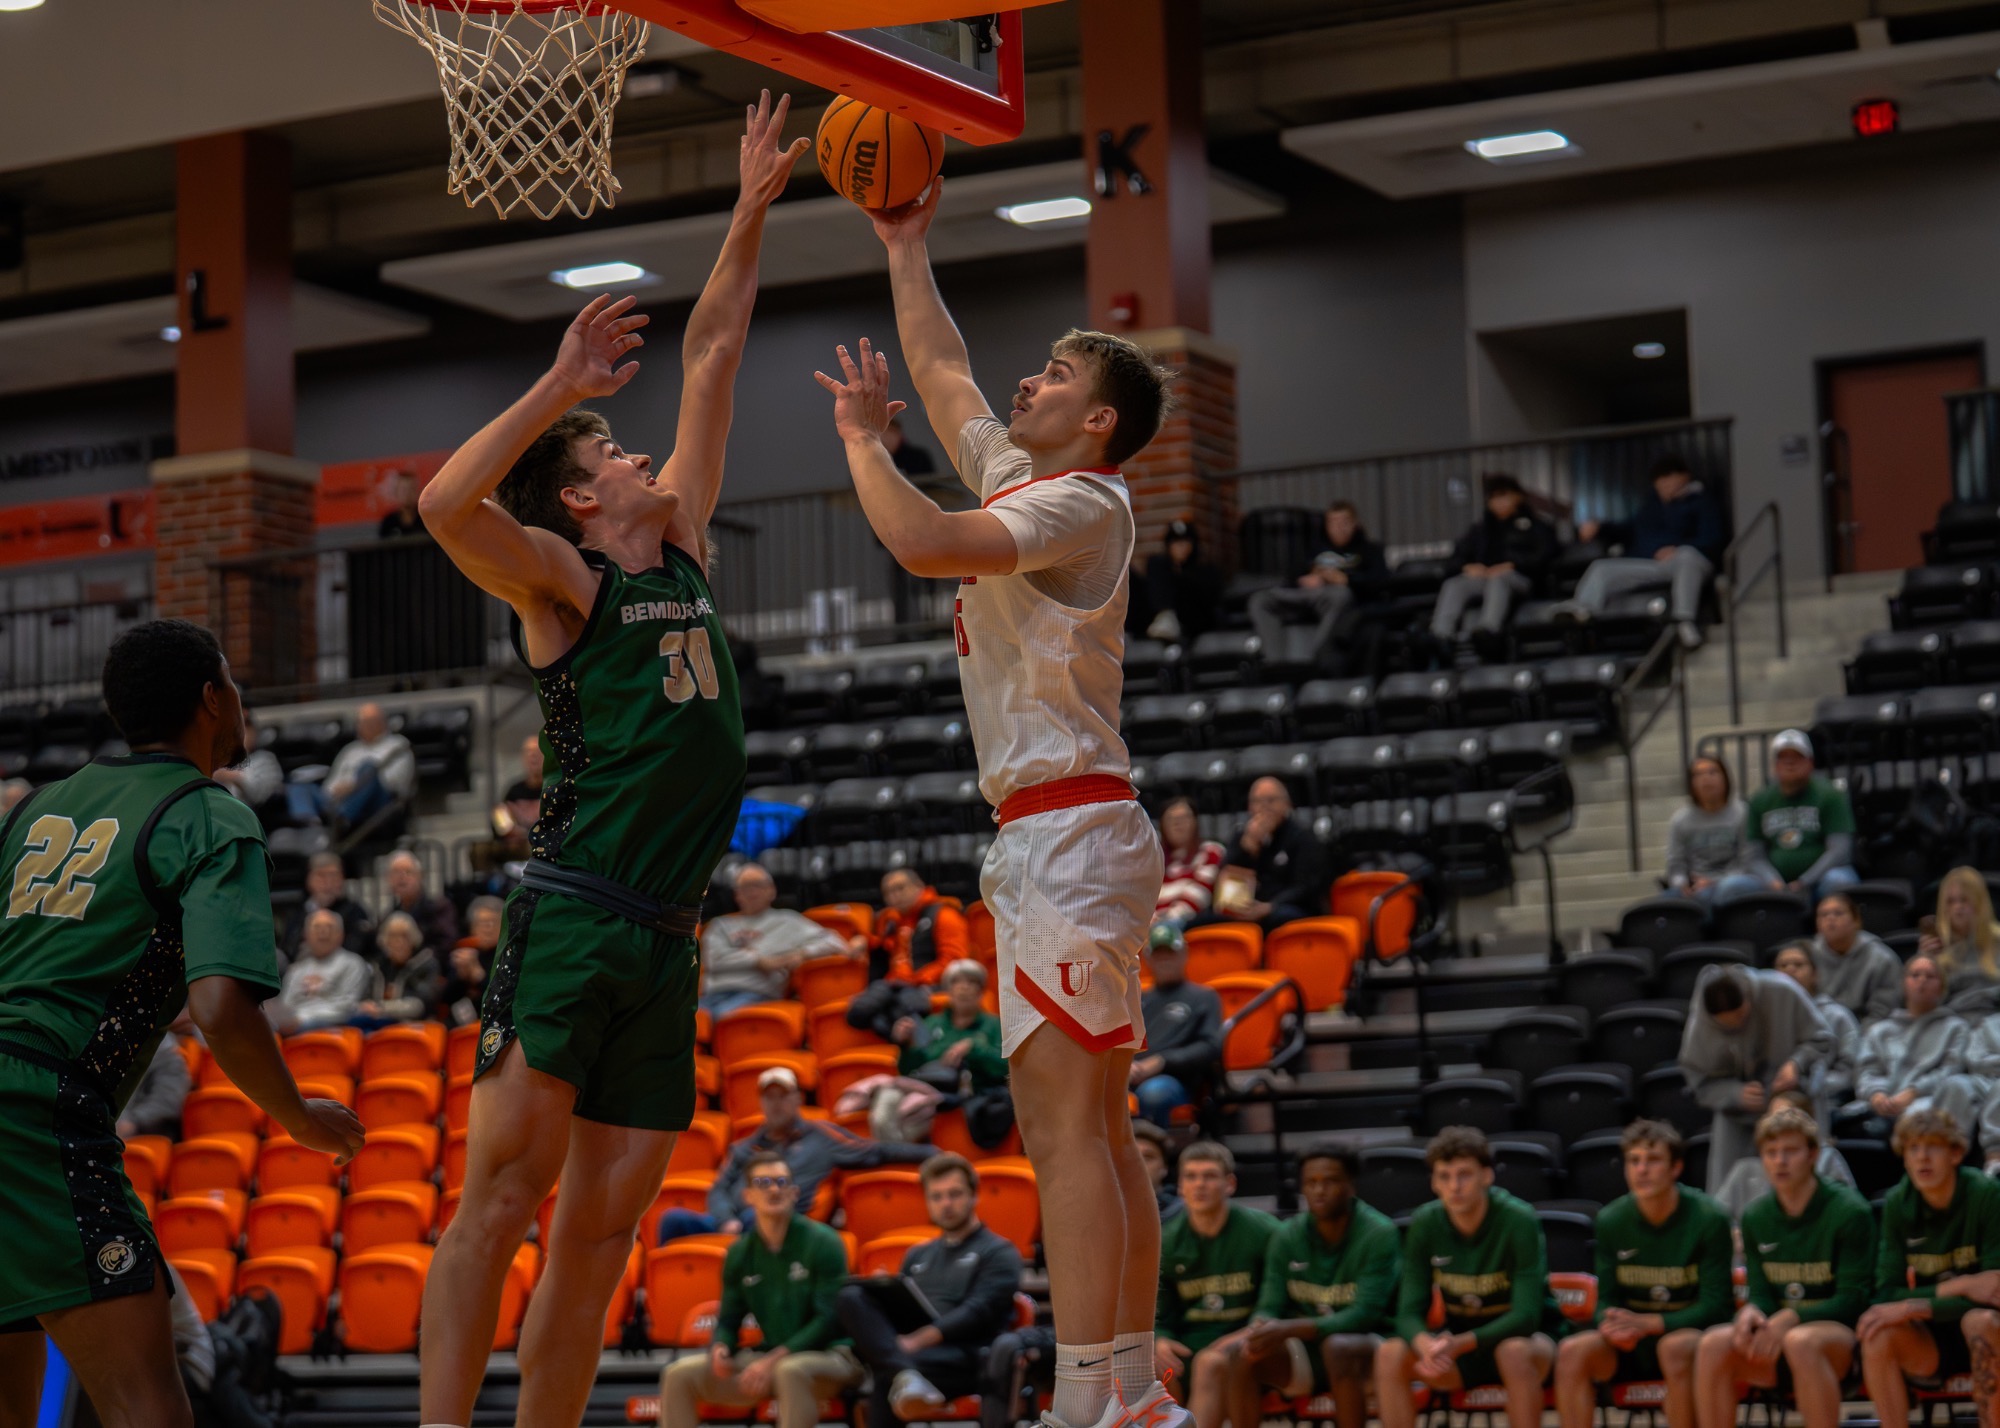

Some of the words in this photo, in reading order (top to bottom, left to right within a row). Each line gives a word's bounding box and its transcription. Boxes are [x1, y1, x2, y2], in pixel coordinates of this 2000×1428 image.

[851, 140, 880, 206] Wilson
[1094, 124, 1151, 197] K
[185, 269, 230, 333] L
[659, 626, 719, 703] 30
[6, 813, 120, 921] 22
[1056, 960, 1093, 997] U
